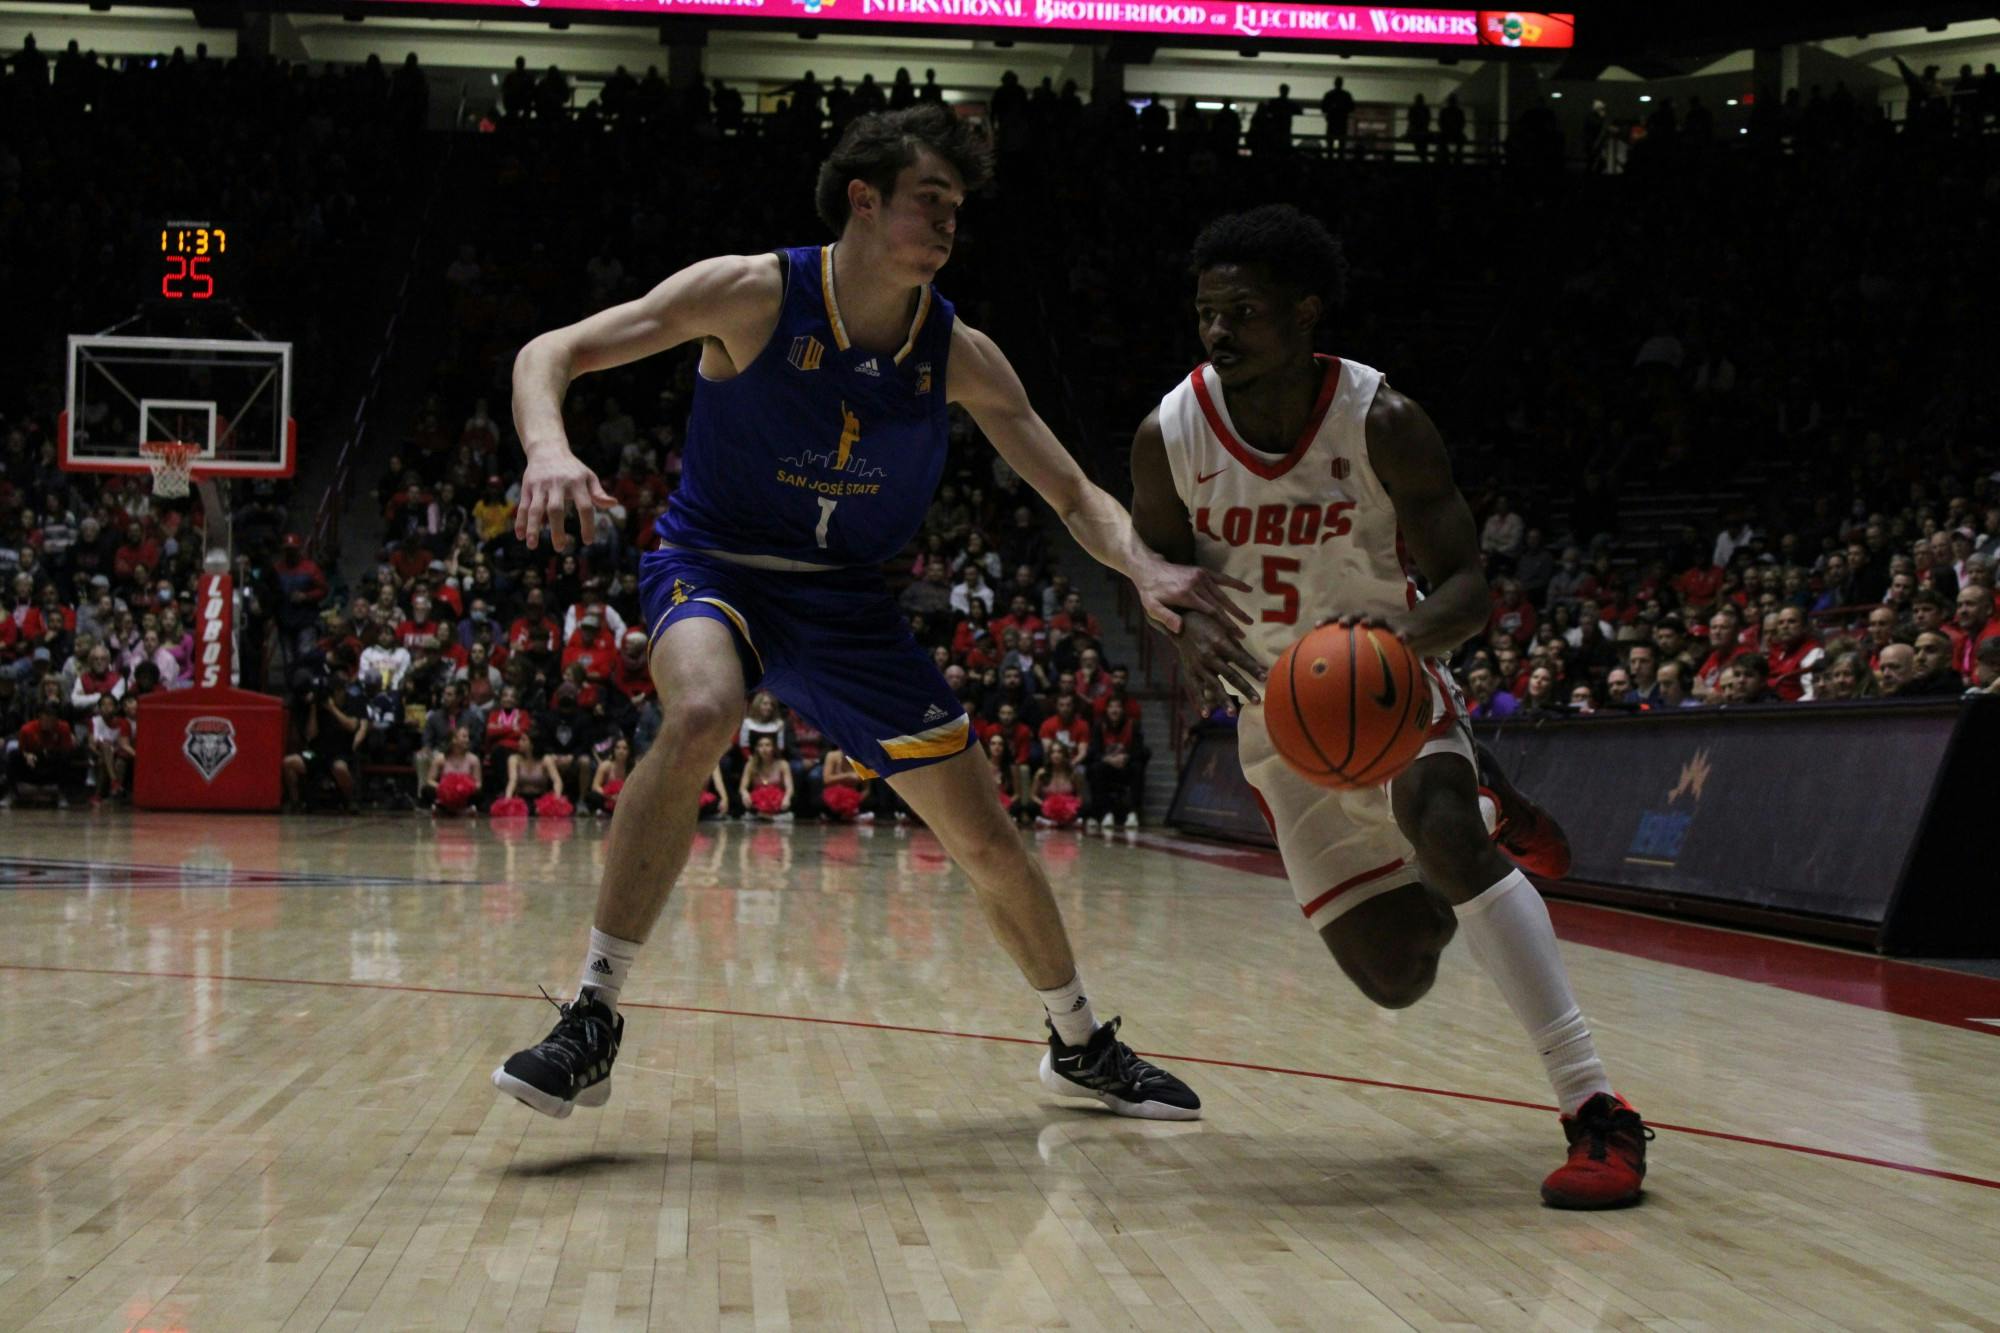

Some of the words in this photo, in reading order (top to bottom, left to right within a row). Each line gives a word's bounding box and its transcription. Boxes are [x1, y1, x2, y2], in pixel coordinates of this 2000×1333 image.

[1035, 0, 1206, 25] BROTHERHOOD
[1233, 4, 1362, 36] ELECTRICAL
[1369, 9, 1478, 36] WORKERS
[161, 229, 226, 254] 11:37
[162, 255, 213, 298] 25
[776, 469, 808, 488] SAN
[845, 483, 881, 496] STATE
[1196, 500, 1357, 548] LOBOS
[1261, 555, 1302, 626] 5
[201, 575, 224, 688] LOBOS
